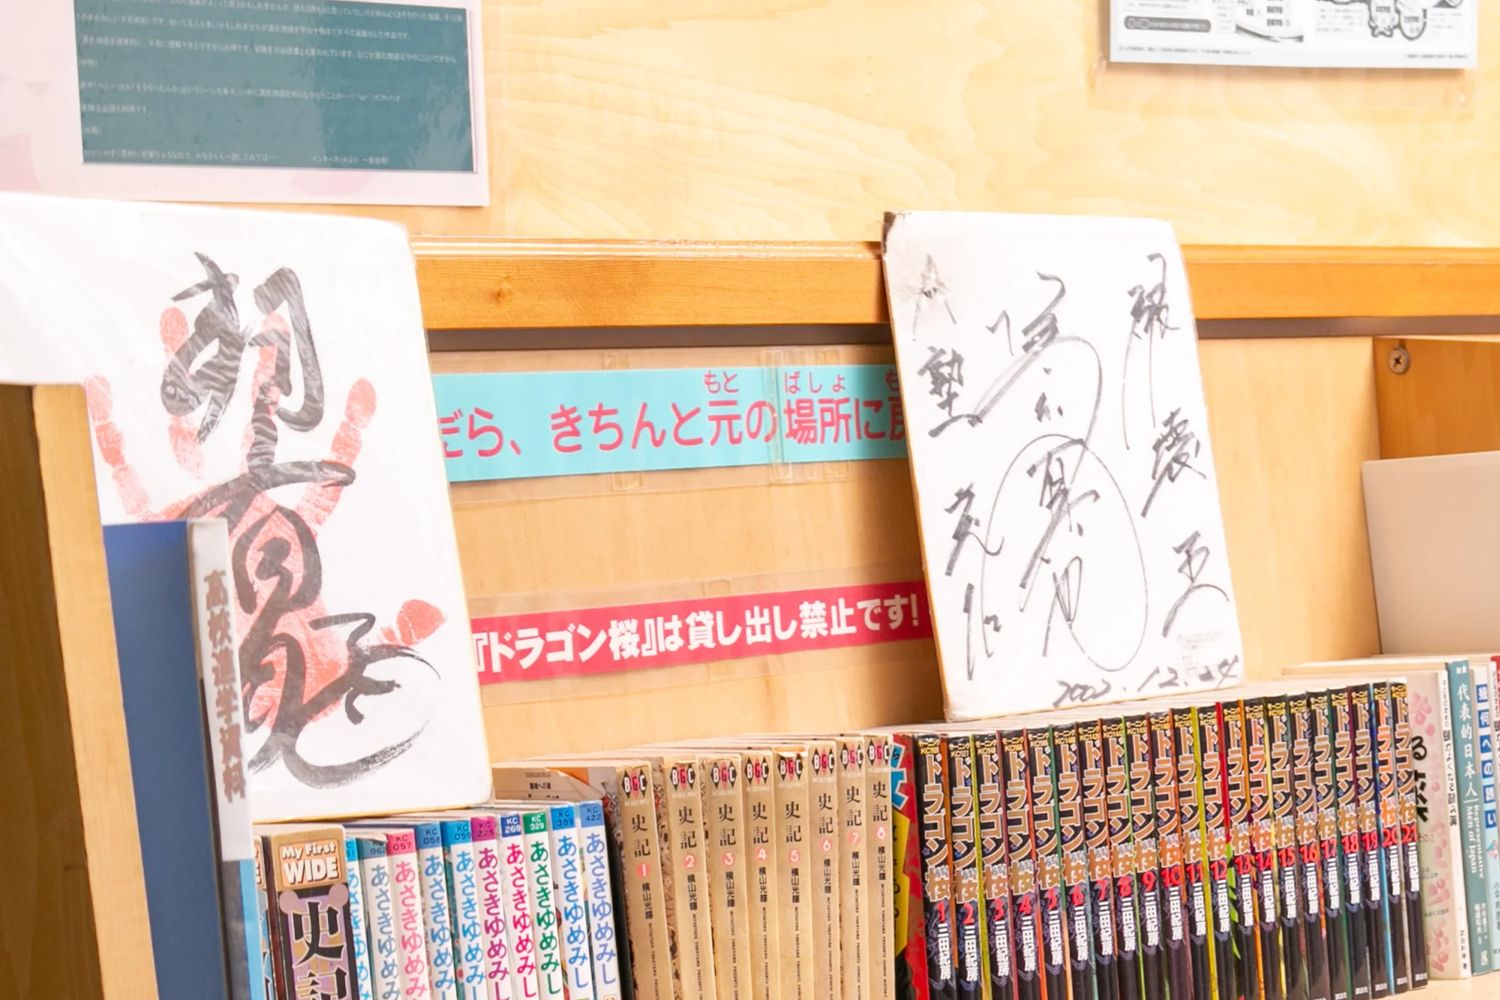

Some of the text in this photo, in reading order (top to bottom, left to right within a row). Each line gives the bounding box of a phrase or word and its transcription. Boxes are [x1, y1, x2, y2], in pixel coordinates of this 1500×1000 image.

[703, 370, 739, 394] もと
[783, 371, 846, 394] ばしょ
[1335, 705, 1358, 835] ドラゴン桜
[1456, 684, 1477, 797] 代表的日本人
[282, 841, 336, 859] My First
[632, 814, 650, 857] 史記
[679, 807, 696, 849] 史記
[718, 804, 736, 847] 史記
[785, 801, 801, 843] 史記
[818, 793, 833, 835] 史記
[872, 781, 888, 822] 史記
[924, 754, 950, 902] ドラゴン桜
[952, 757, 979, 903] ドラゴン桜
[980, 754, 1008, 899] ドラゴン桜
[1059, 744, 1085, 885] ドラゴン桜
[1155, 731, 1181, 868] ドラゴン桜
[283, 859, 339, 884] WIDE
[507, 843, 536, 998] あさきゆめみし
[530, 841, 560, 994] あさきゆめみし
[558, 836, 588, 988] あさきゆめみし
[586, 833, 615, 984] あさきゆめみし
